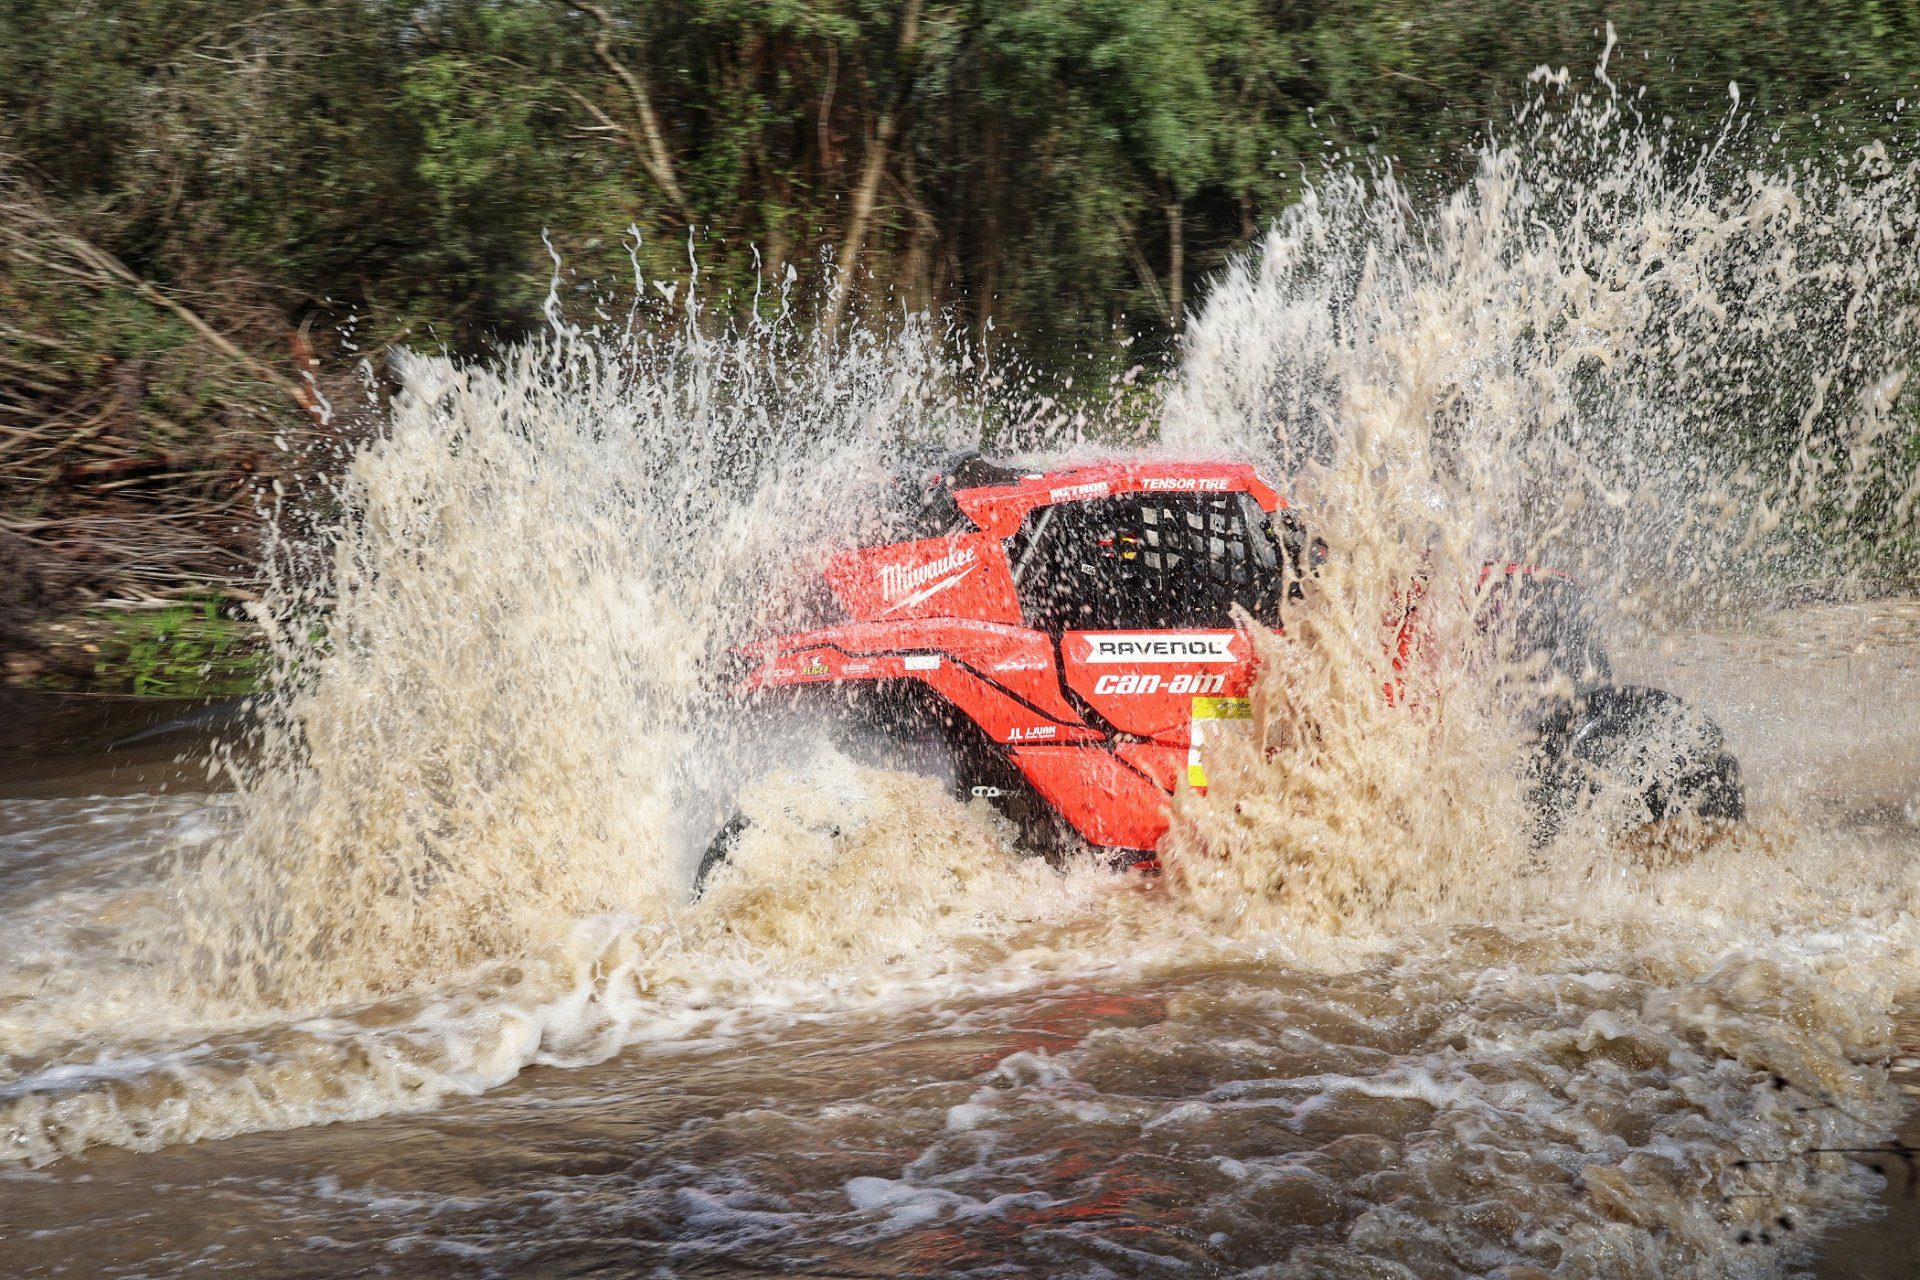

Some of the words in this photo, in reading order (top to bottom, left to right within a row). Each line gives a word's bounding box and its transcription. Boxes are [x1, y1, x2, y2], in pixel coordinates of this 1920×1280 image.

[1142, 478, 1196, 490] TENSOR
[1198, 479, 1228, 490] TIRE
[874, 547, 978, 601] Milwaukee
[1099, 641, 1223, 655] RAVENOL
